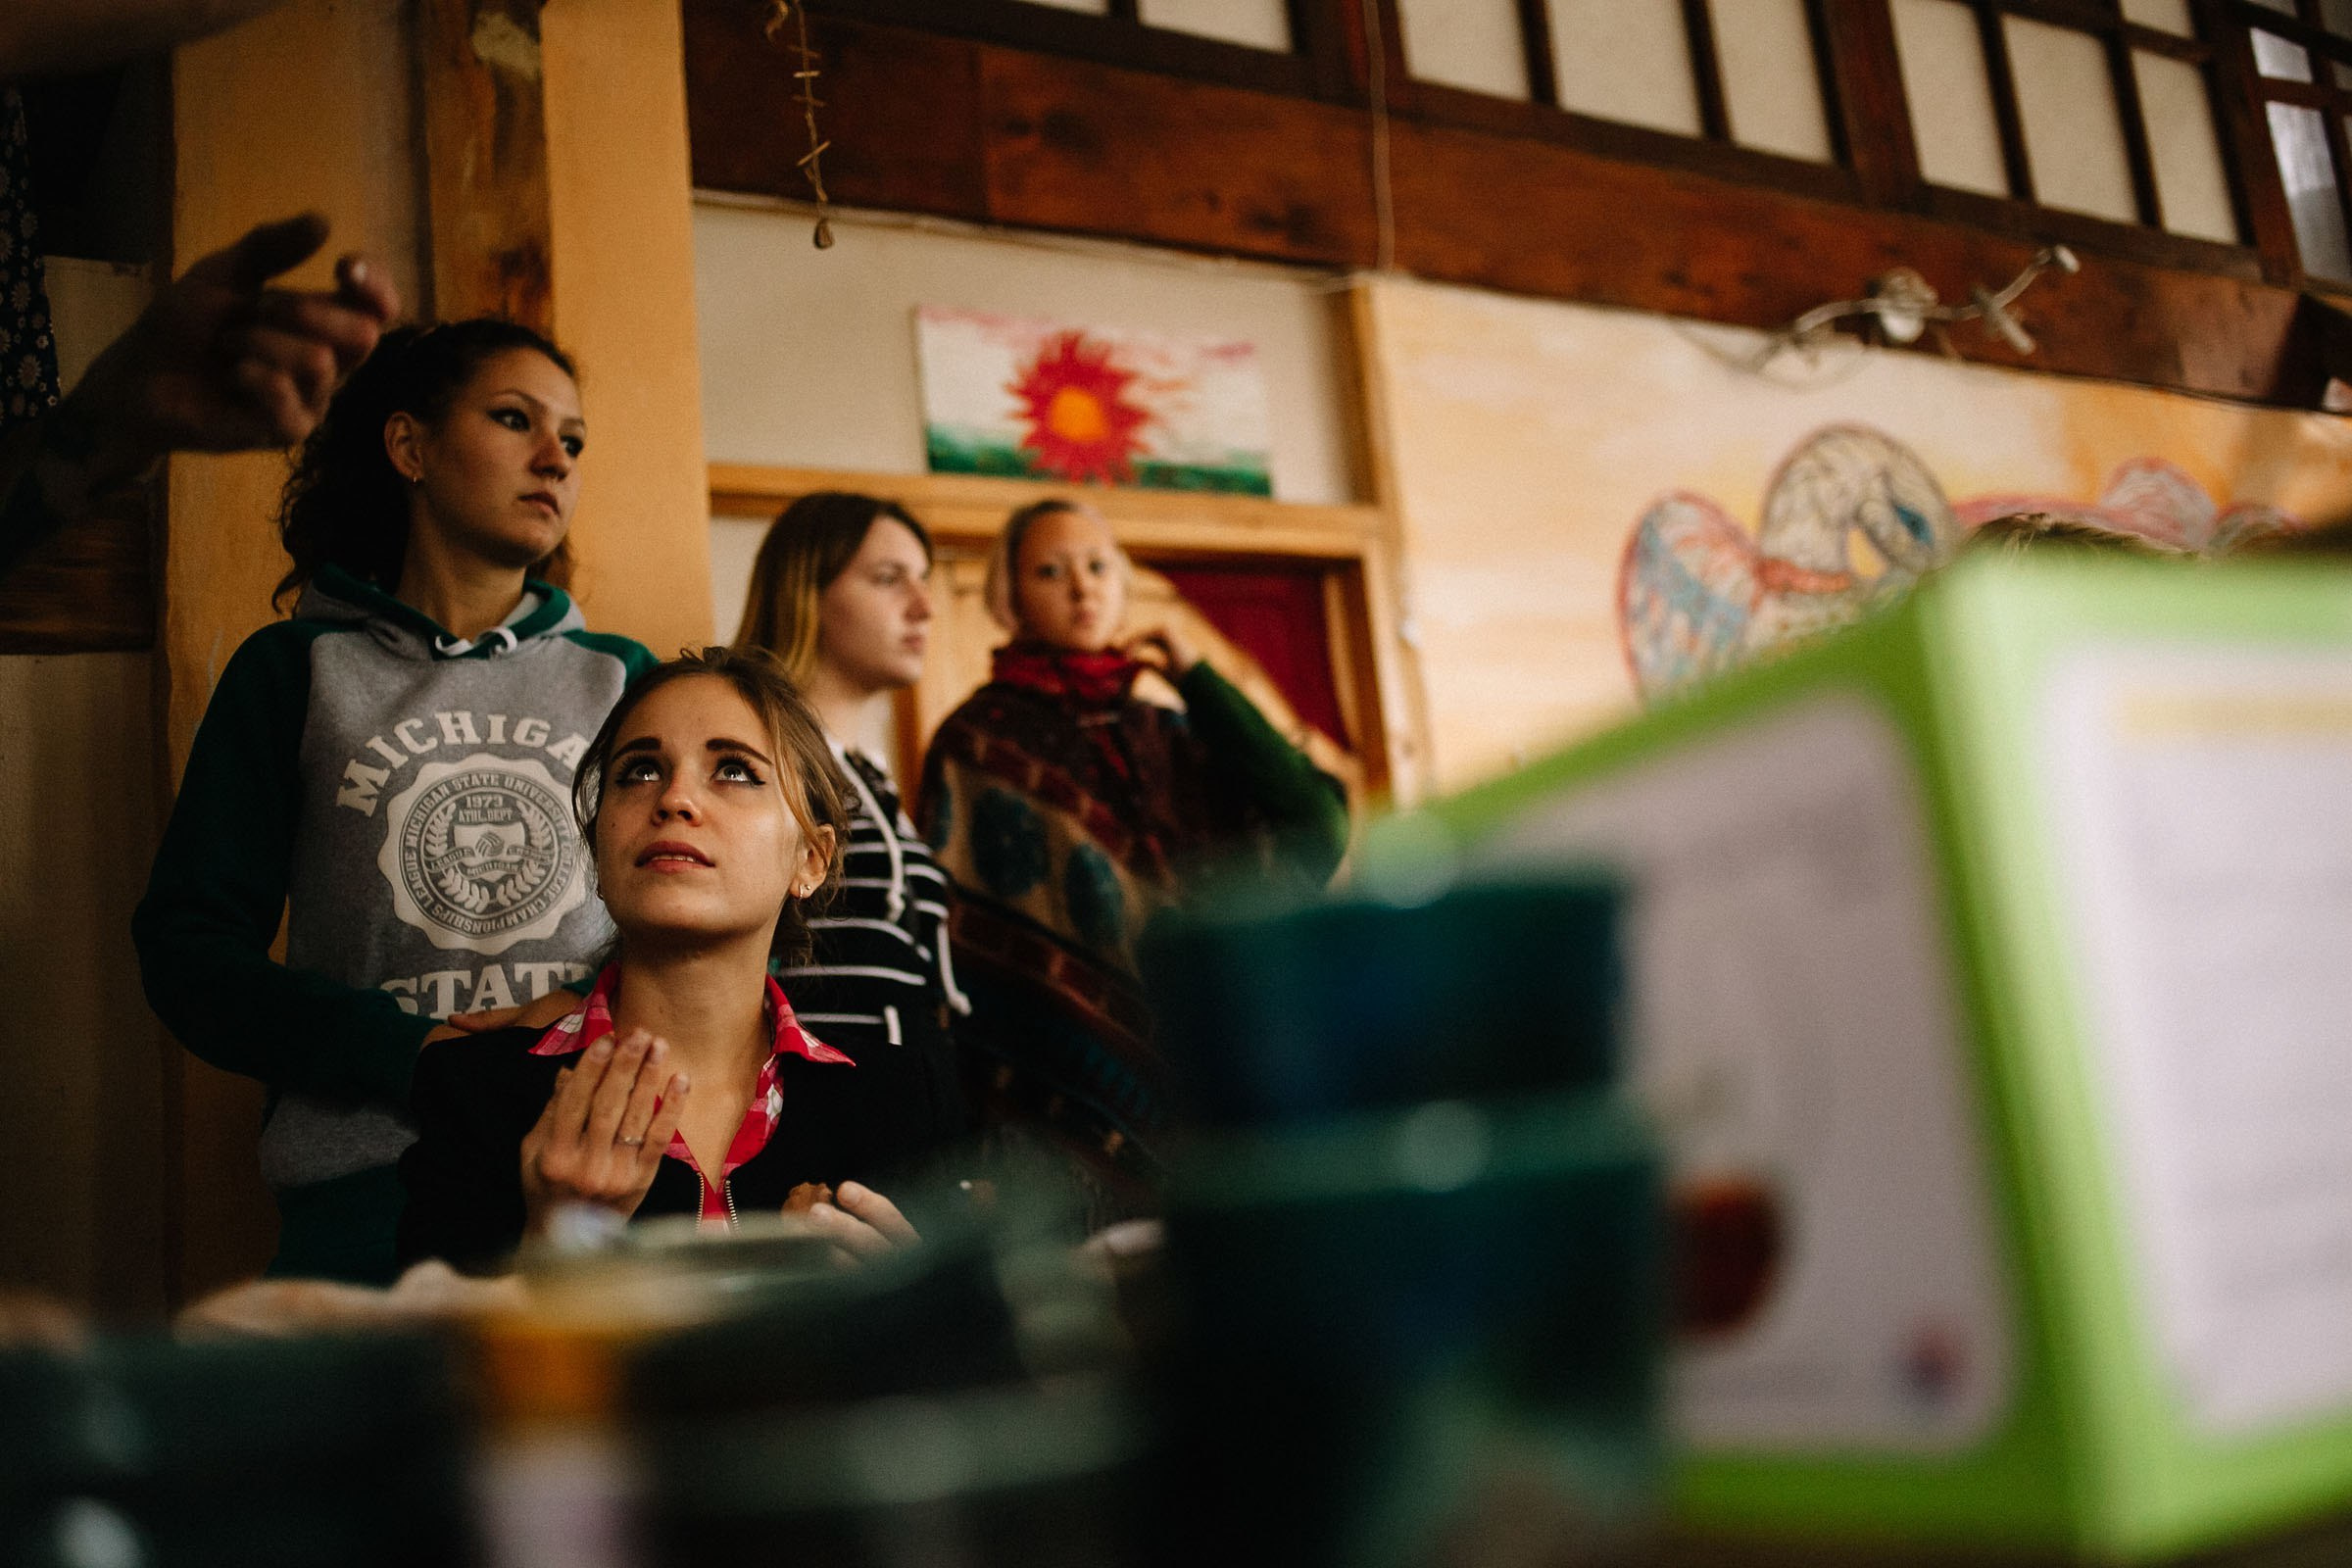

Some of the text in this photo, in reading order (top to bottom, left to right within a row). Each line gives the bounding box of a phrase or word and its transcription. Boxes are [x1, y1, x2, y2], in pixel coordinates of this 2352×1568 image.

[335, 710, 592, 818] MICHIGA
[452, 773, 500, 792] STATE
[405, 783, 450, 846] MICHIGAN
[466, 795, 503, 809] 1973
[405, 851, 435, 908] LEAGUE
